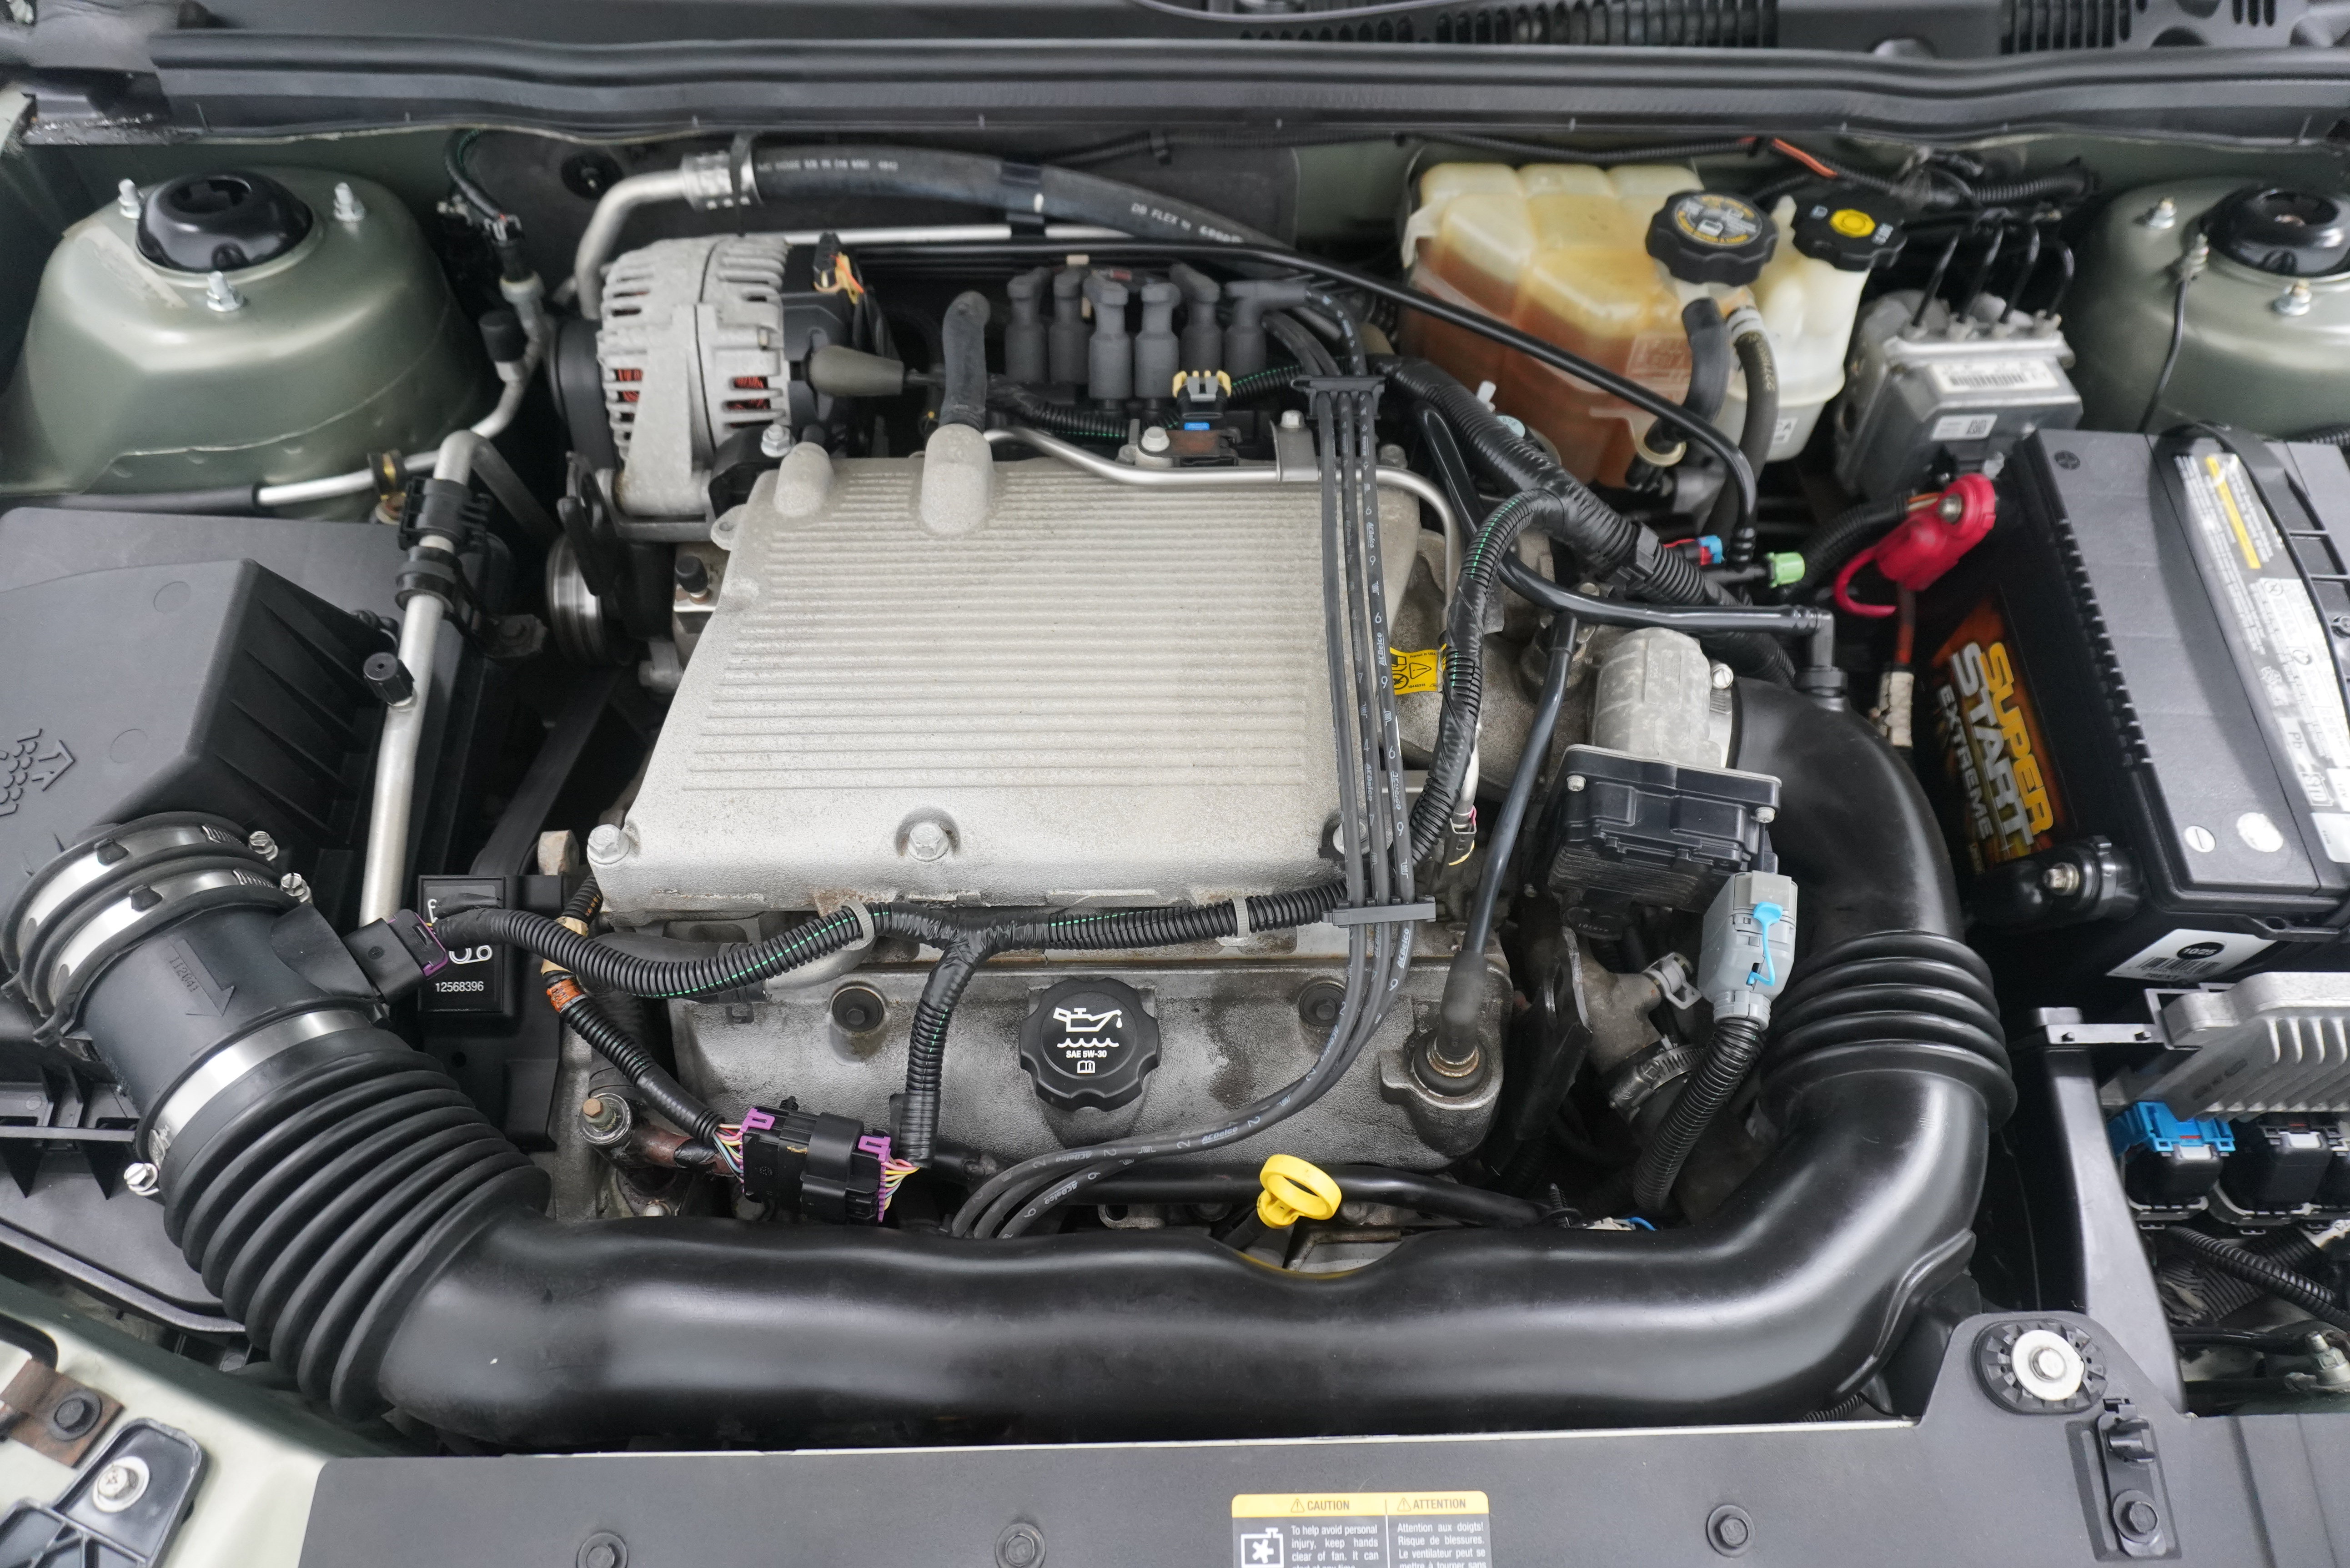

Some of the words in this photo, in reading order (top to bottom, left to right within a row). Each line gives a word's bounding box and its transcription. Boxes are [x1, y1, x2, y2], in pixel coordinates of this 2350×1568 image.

[1375, 612, 1381, 623] 6
[1377, 632, 1387, 666] ACDelco
[1949, 642, 2034, 846] START
[1981, 641, 2054, 835] SUPER
[2288, 732, 2304, 749] Pb
[1389, 745, 1396, 759] 6
[1938, 684, 1994, 839] EXTREME
[1397, 928, 1411, 969] ACDelco
[435, 981, 484, 992] 12568396
[1339, 1001, 1346, 1016] 2
[1321, 1025, 1339, 1061] ACDelco
[1066, 1050, 1081, 1058] SAE
[1083, 1050, 1107, 1058] 5W-30
[1247, 1116, 1260, 1127] 2
[1202, 1127, 1238, 1145] ACDelco
[1177, 1140, 1190, 1149] 2
[1055, 1150, 1092, 1162] ACDelco
[1044, 1180, 1078, 1204] ACDelco
[1307, 1501, 1350, 1510] CAUTION
[1413, 1499, 1466, 1509] ATTENTION
[1291, 1525, 1300, 1535] To
[1302, 1525, 1319, 1536] help
[1321, 1525, 1341, 1535] avoid
[1345, 1524, 1377, 1536] personal
[1397, 1523, 1433, 1533] Attention
[1438, 1523, 1452, 1532] aux
[1457, 1522, 1484, 1533] doigts!
[1291, 1538, 1316, 1550] injury,
[1325, 1538, 1345, 1549] keep
[1354, 1537, 1378, 1548] hands
[1398, 1536, 1425, 1547] Risque
[1430, 1535, 1440, 1545] de
[1444, 1535, 1485, 1545] blessures.
[1292, 1551, 1312, 1562] clear
[1317, 1551, 1326, 1561] of
[1331, 1551, 1347, 1561] fan.
[1353, 1550, 1358, 1560] It
[1364, 1551, 1379, 1560] can
[1399, 1549, 1409, 1559] Le
[1412, 1548, 1452, 1558] ventilateur
[1456, 1548, 1473, 1559] peut
[1476, 1548, 1486, 1557] se
